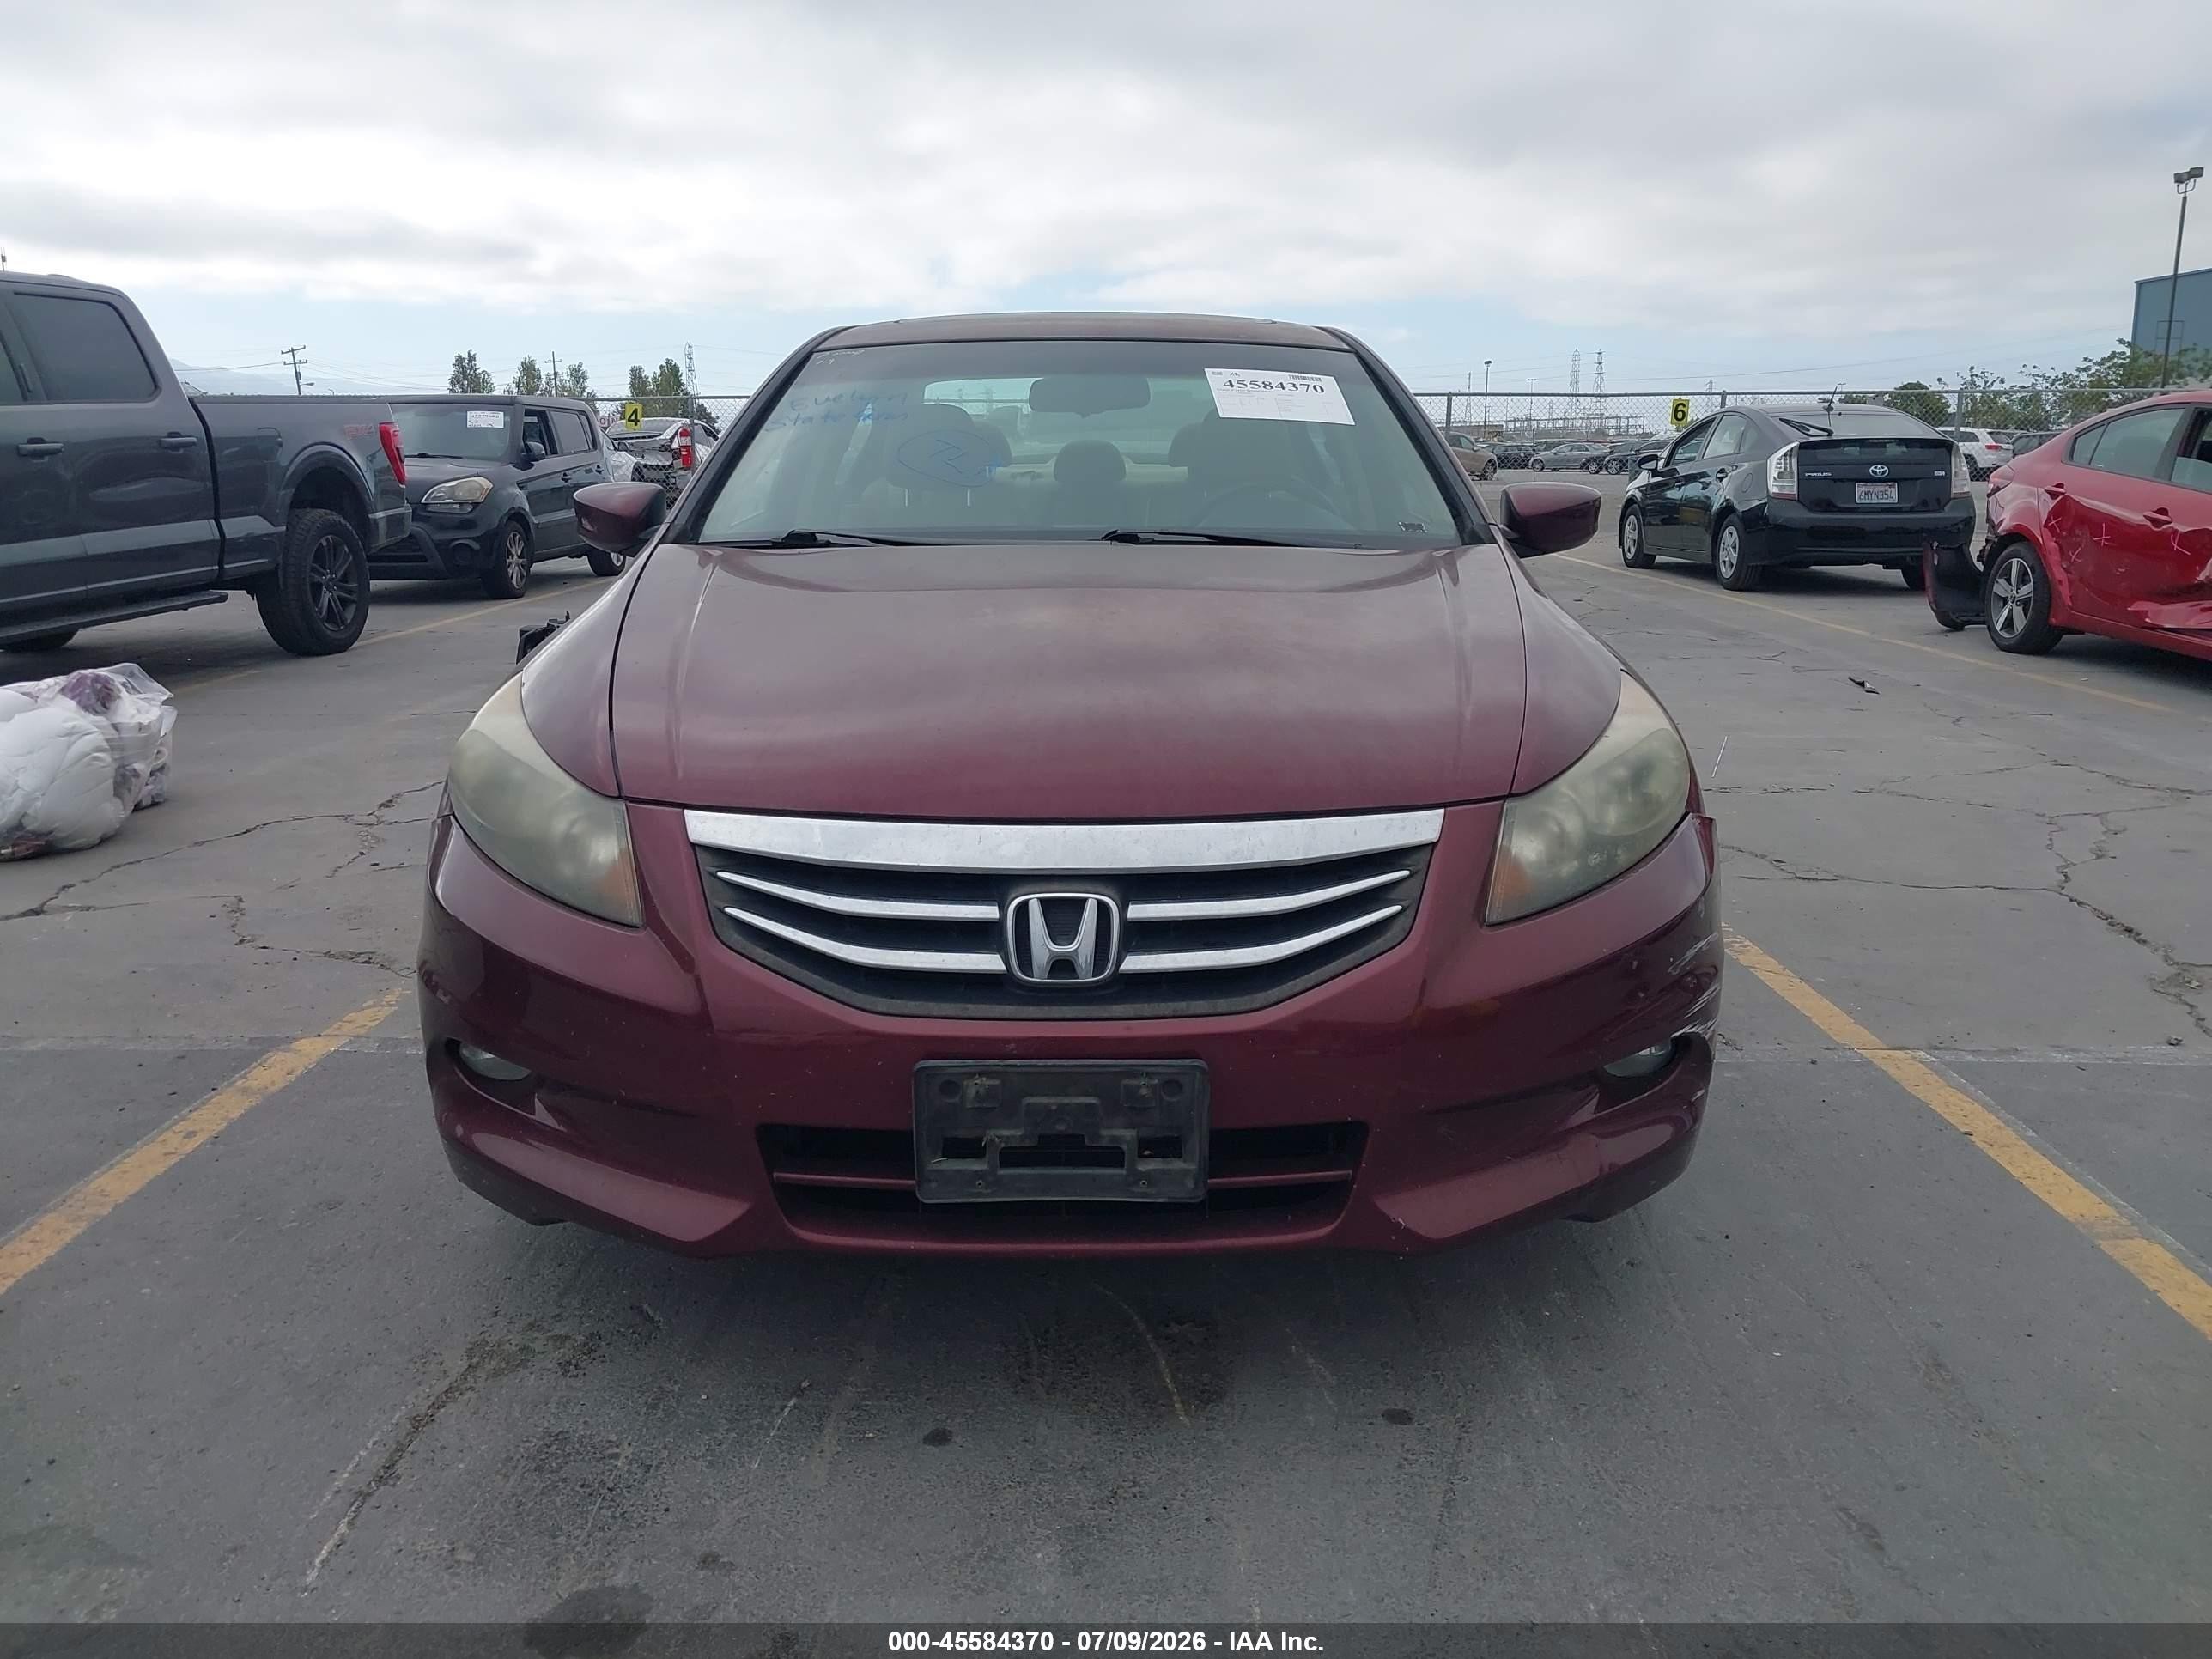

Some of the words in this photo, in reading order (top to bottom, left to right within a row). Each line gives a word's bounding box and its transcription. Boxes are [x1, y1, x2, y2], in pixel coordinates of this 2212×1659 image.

[1223, 379, 1325, 394] 45584370
[627, 407, 641, 427] 4
[1674, 402, 1686, 422] 6
[1859, 489, 1894, 501] 6MYN354
